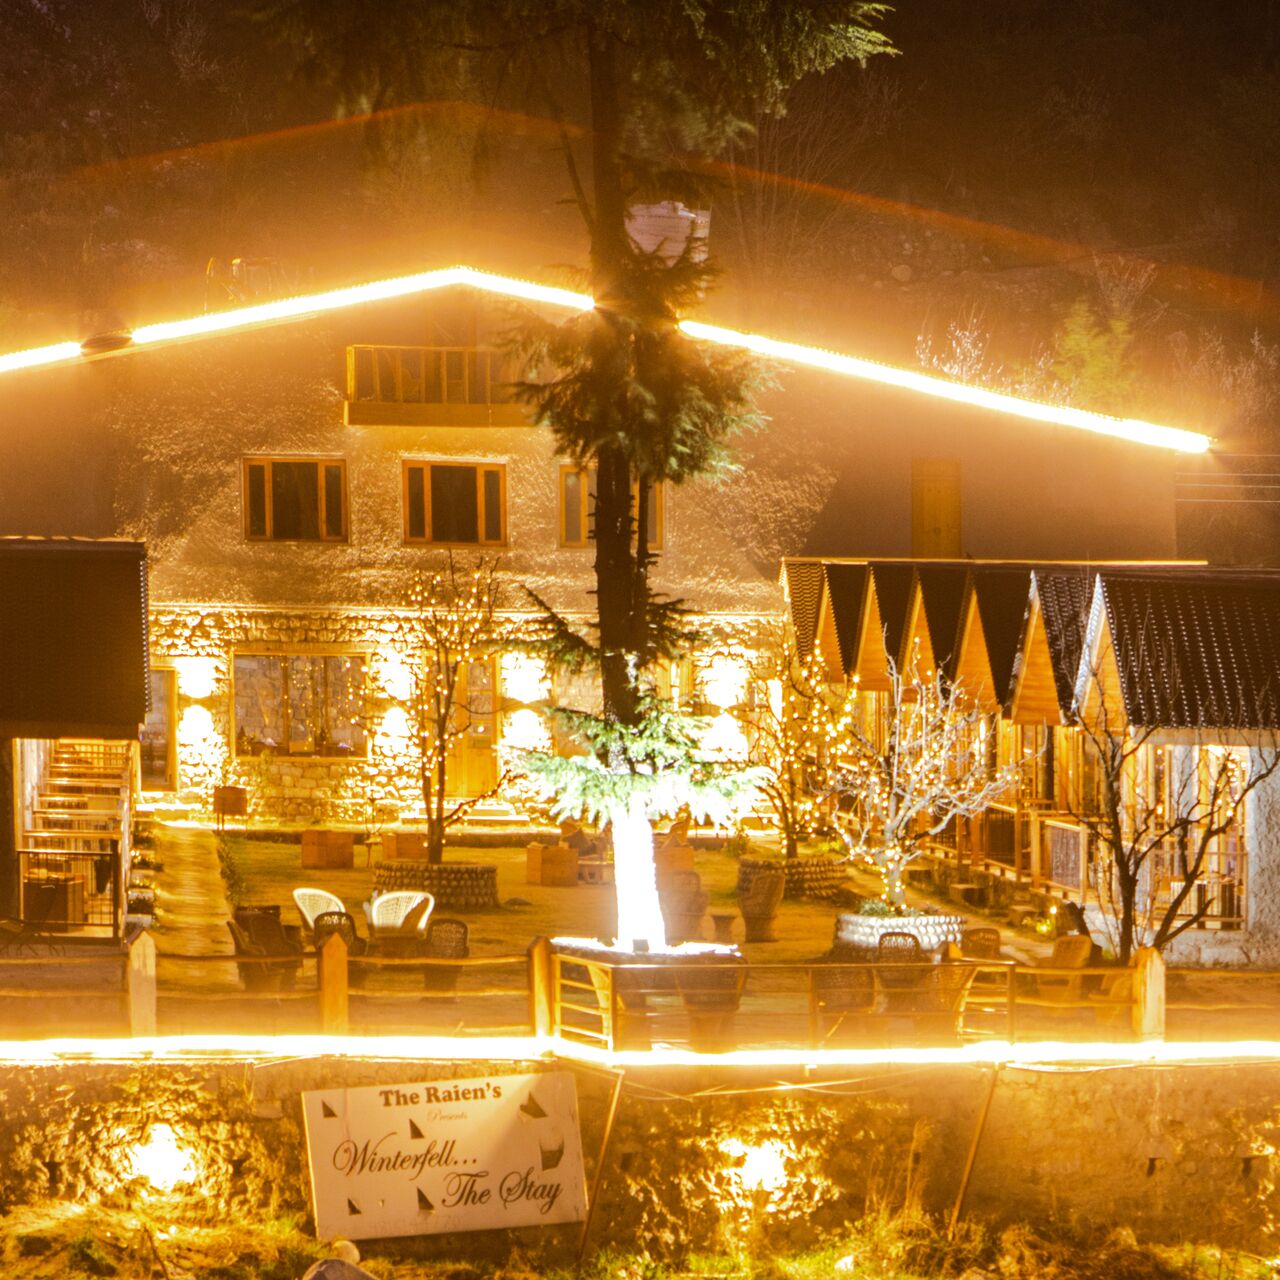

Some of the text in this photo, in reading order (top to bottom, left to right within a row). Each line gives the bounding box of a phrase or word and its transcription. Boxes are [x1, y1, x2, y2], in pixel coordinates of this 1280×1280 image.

[379, 1082, 502, 1108] The Raien's
[426, 1109, 468, 1123] Presents
[332, 1131, 478, 1182] Winterfell...
[442, 1166, 562, 1215] The Stay
